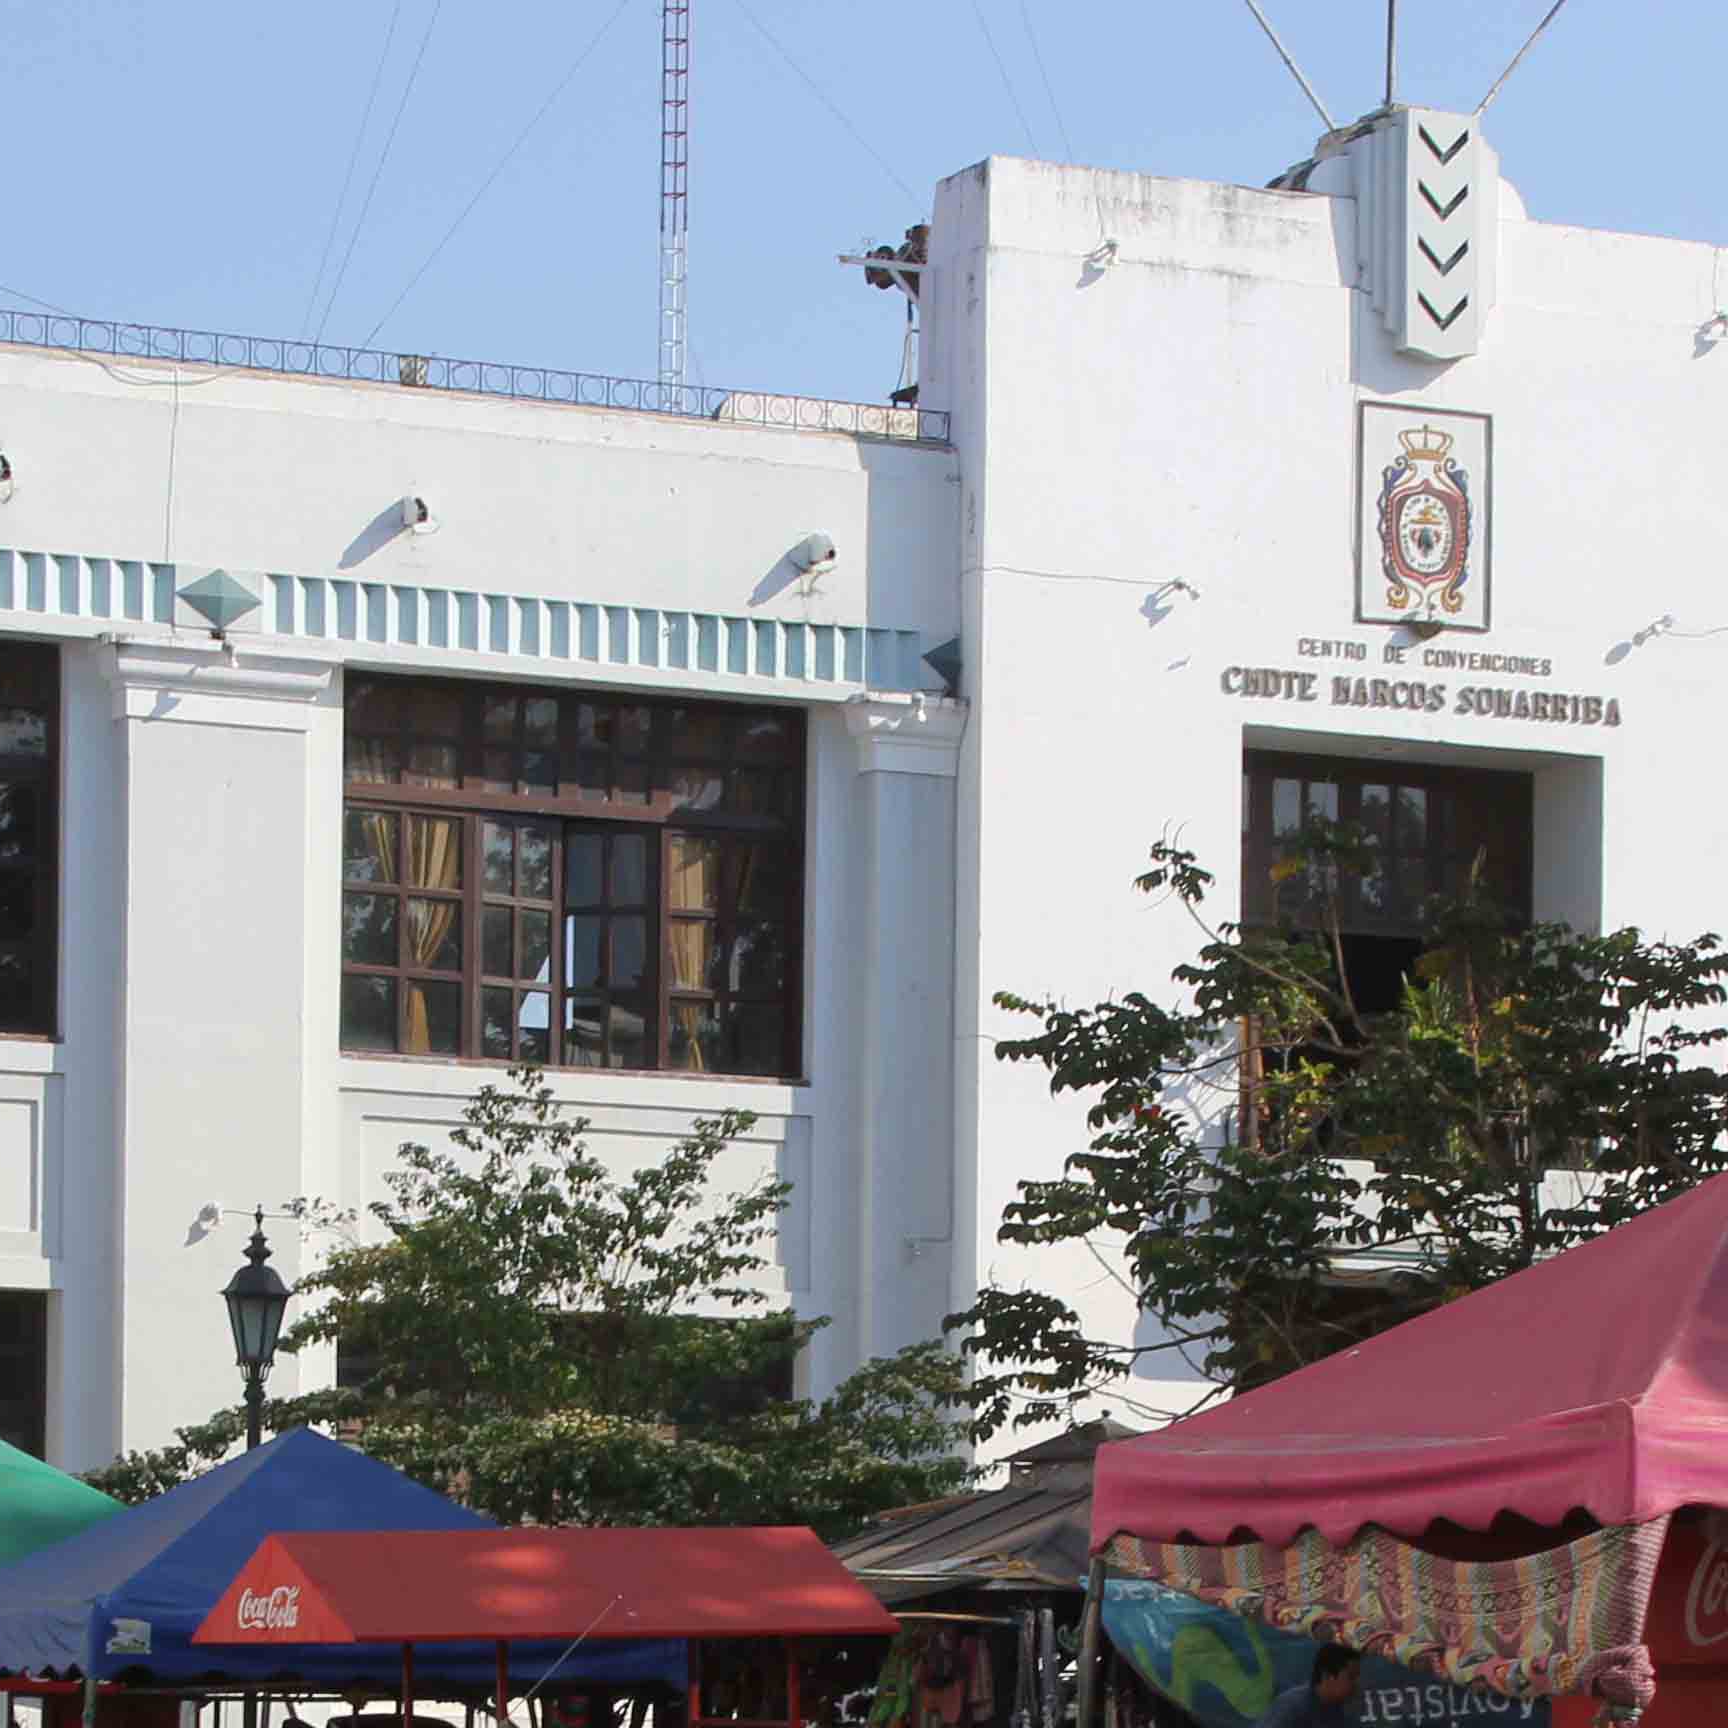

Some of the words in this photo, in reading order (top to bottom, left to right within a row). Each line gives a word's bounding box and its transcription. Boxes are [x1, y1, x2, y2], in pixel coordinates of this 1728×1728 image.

[1298, 637, 1367, 662] CENTRO
[1383, 645, 1407, 665] DE
[1423, 648, 1552, 676] CONVENCIONES
[1331, 674, 1447, 713] MARCOS
[1454, 685, 1623, 729] SOMARRIBA
